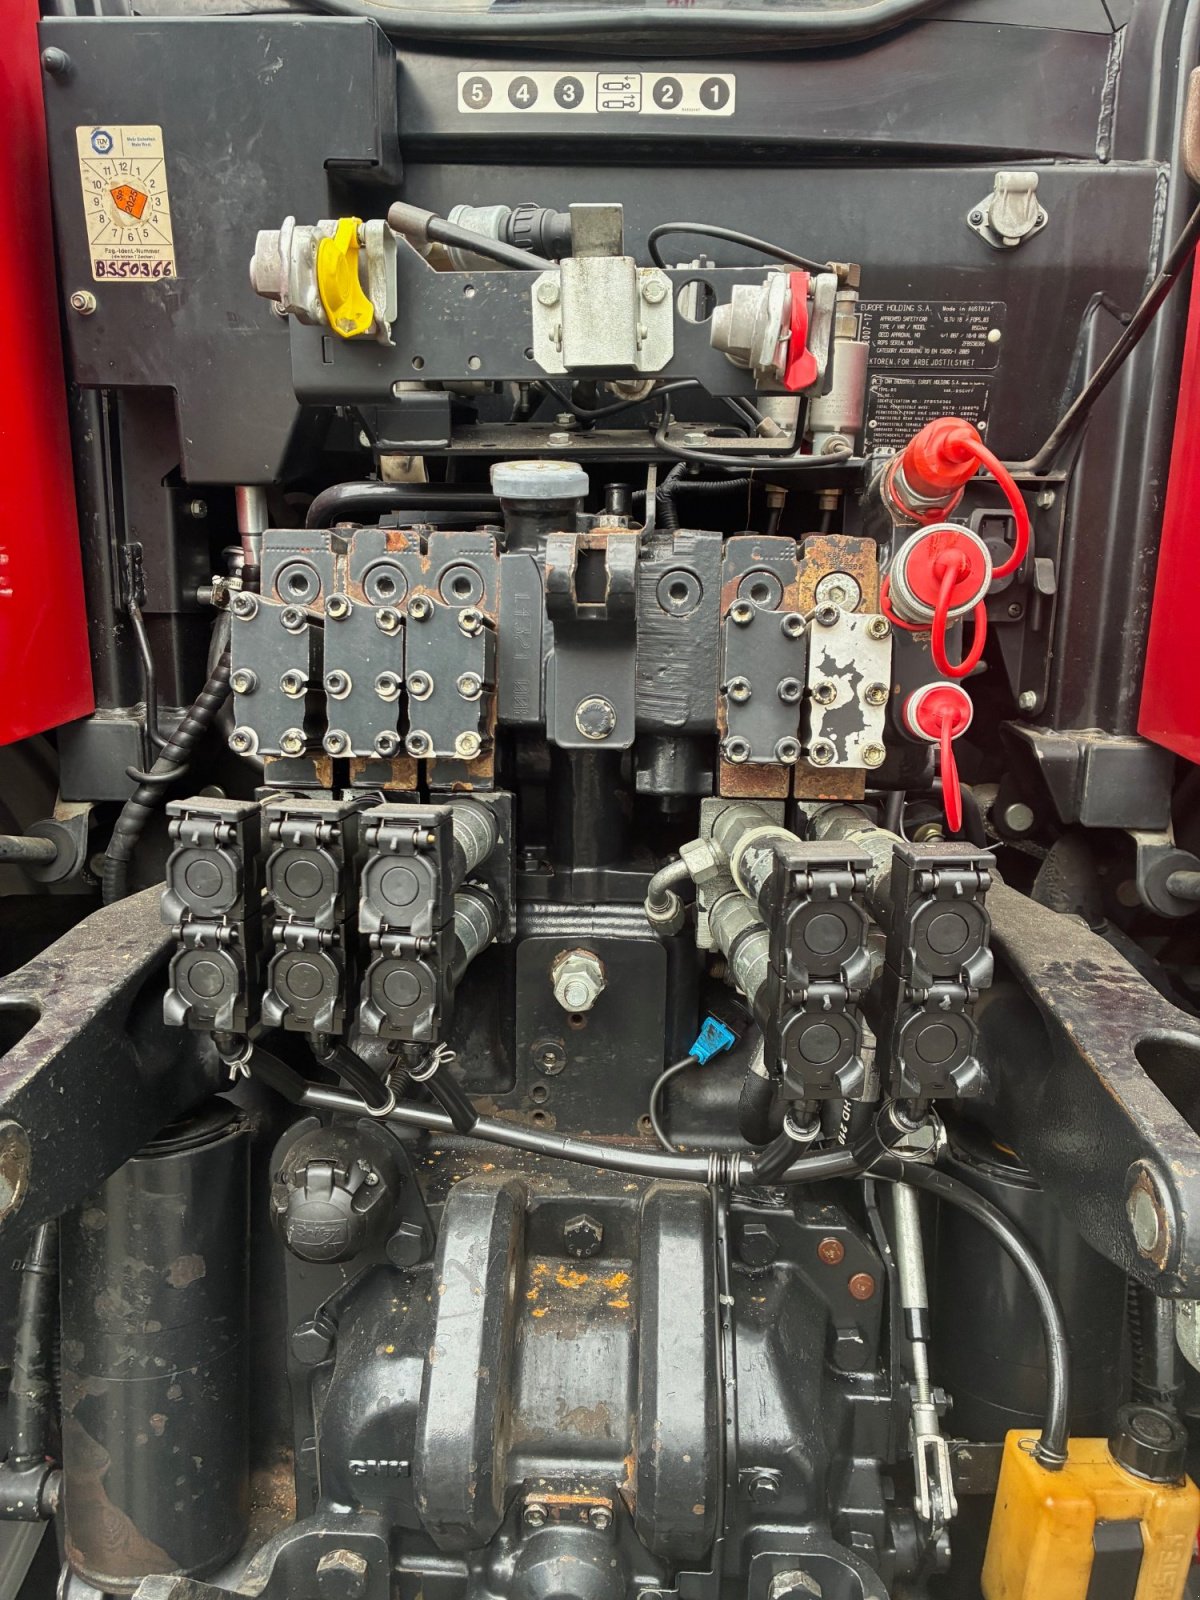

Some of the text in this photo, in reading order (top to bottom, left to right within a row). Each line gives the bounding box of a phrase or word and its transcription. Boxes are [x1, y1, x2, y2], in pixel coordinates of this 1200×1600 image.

[471, 84, 719, 102] 5 4 3 2 1
[103, 166, 110, 175] 11
[118, 162, 127, 171] 12
[136, 167, 140, 175] 1
[92, 180, 101, 189] 10
[150, 180, 155, 188] 2
[94, 198, 99, 206] 9
[125, 190, 138, 213] 2025
[156, 196, 161, 206] 3
[99, 215, 105, 223] 8
[152, 215, 158, 223] 4
[112, 229, 117, 237] 7
[128, 233, 134, 241] 6
[143, 229, 149, 237] 5
[96, 260, 171, 276] BS50366
[842, 1099, 852, 1121] HD
